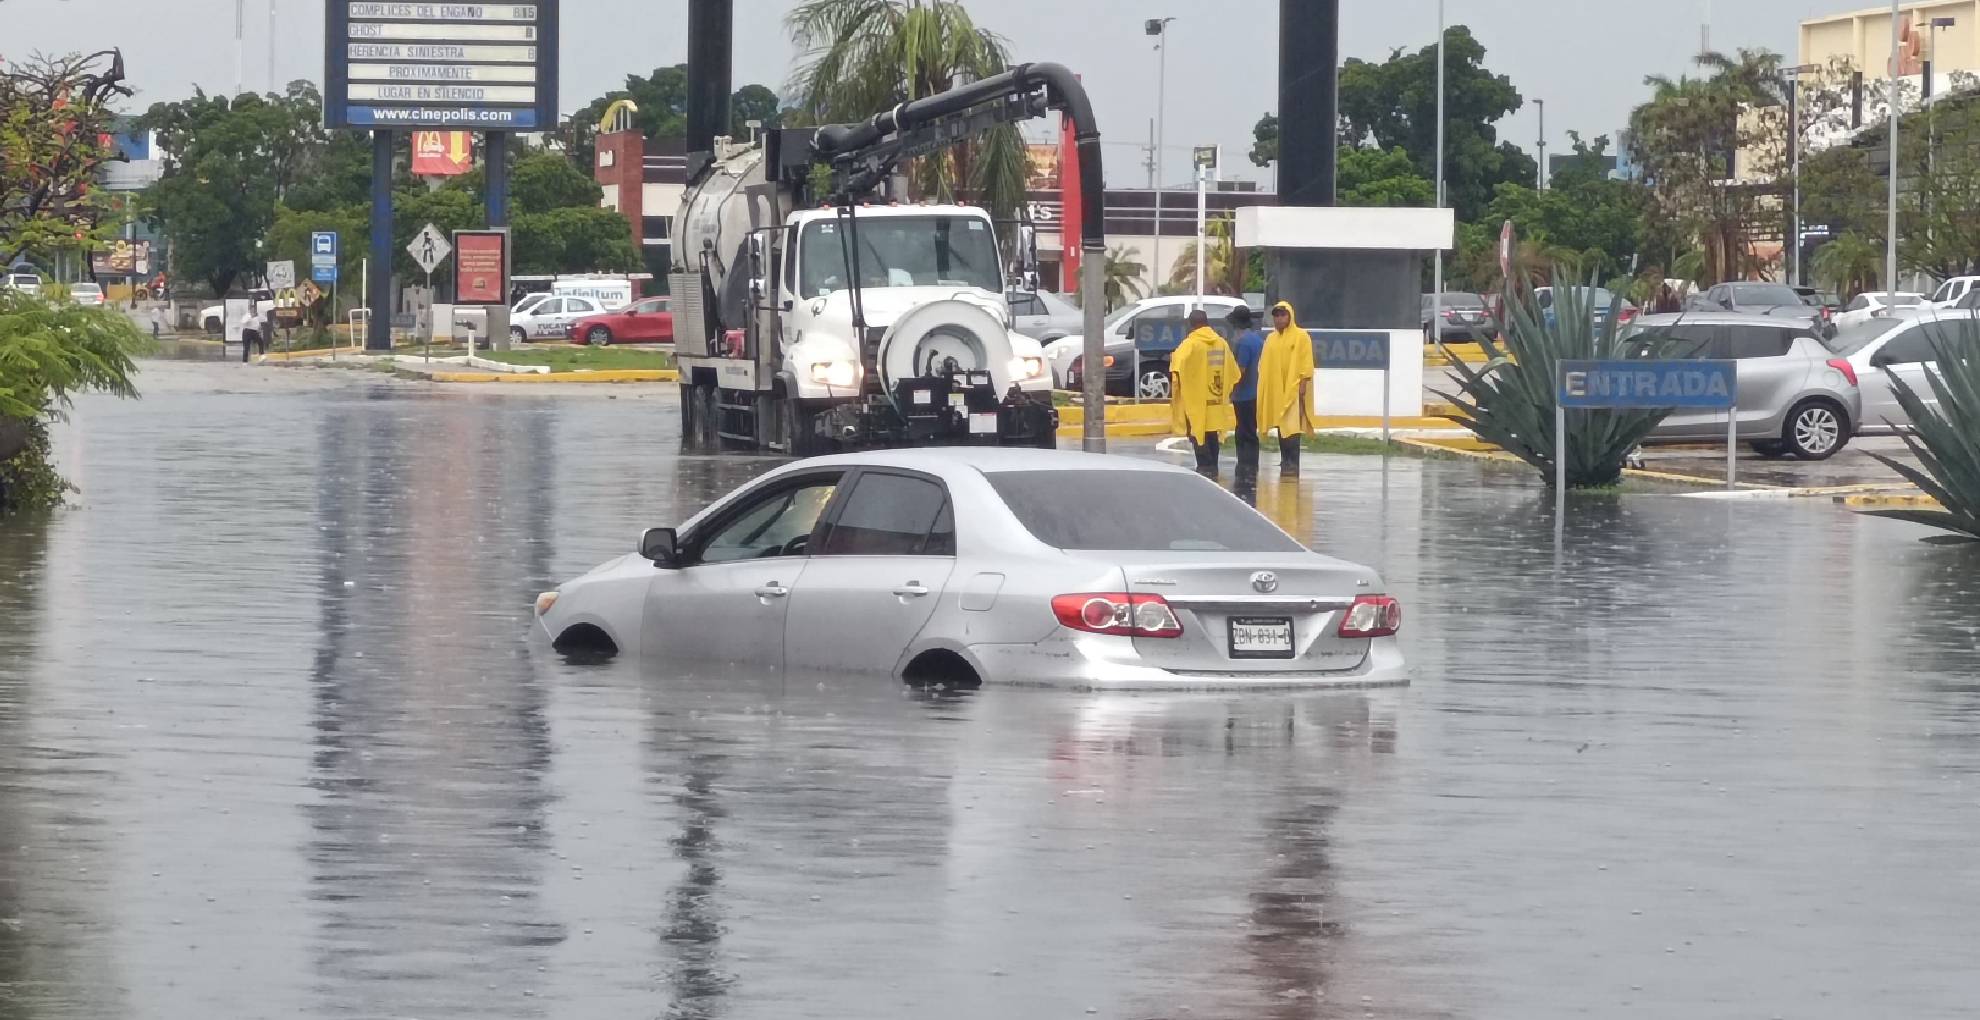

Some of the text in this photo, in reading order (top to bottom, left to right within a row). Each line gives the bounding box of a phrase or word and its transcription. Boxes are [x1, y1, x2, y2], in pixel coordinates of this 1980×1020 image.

[350, 4, 411, 16] COMPLICES
[417, 5, 436, 17] DEL
[349, 24, 383, 36] GHOST
[349, 45, 400, 57] HERENCIA
[407, 46, 464, 58] SINIESTRA
[389, 66, 472, 79] PROXIMAMENTE
[378, 87, 484, 99] LUGAR EN SILENCIO
[373, 107, 512, 122] www.cinepolis.com
[1565, 371, 1728, 396] ENTRADA
